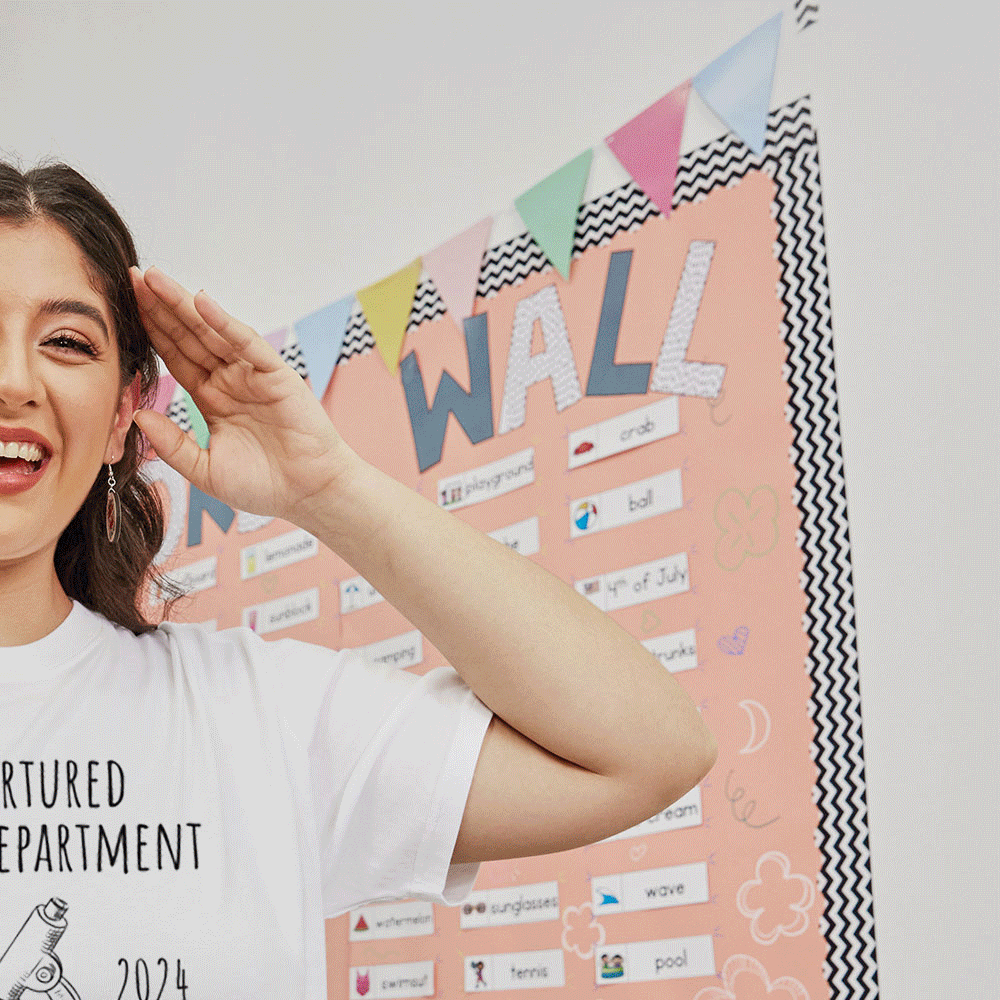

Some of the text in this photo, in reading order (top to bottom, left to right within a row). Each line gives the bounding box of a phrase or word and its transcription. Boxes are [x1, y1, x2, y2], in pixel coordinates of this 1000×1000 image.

[400, 239, 727, 473] WALL
[619, 416, 655, 441] crab
[466, 455, 534, 498] playground
[628, 488, 655, 513] ball
[632, 571, 650, 592] of
[656, 564, 688, 585] July
[644, 882, 686, 899] wave
[491, 894, 559, 918] sunglasses
[510, 962, 549, 979] tennis
[655, 948, 688, 974] pool
